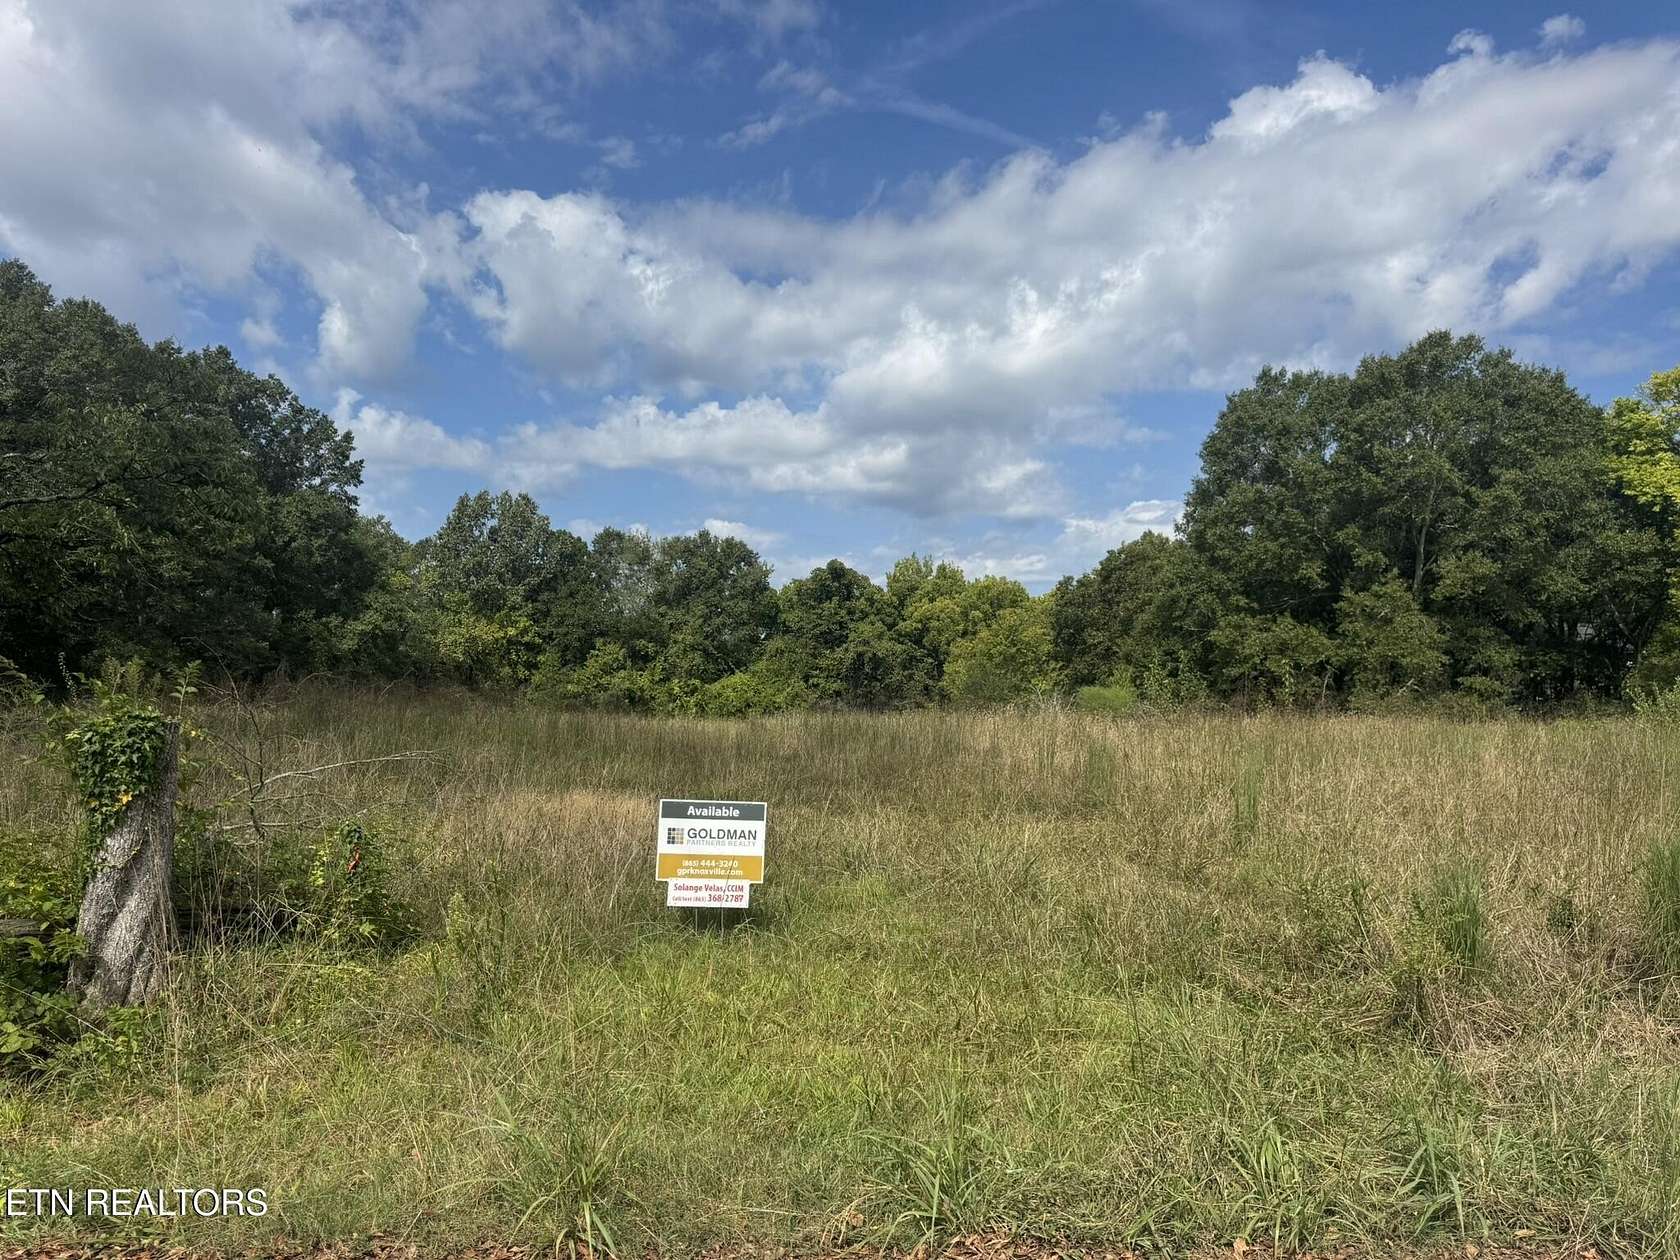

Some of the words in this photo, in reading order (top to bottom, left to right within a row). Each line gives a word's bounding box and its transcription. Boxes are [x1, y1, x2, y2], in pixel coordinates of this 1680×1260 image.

[687, 805, 740, 817] Available
[687, 828, 757, 840] GOLDMAN
[682, 859, 699, 868] (865)
[676, 867, 744, 877] gprknoxville.com
[673, 883, 703, 893] Solange
